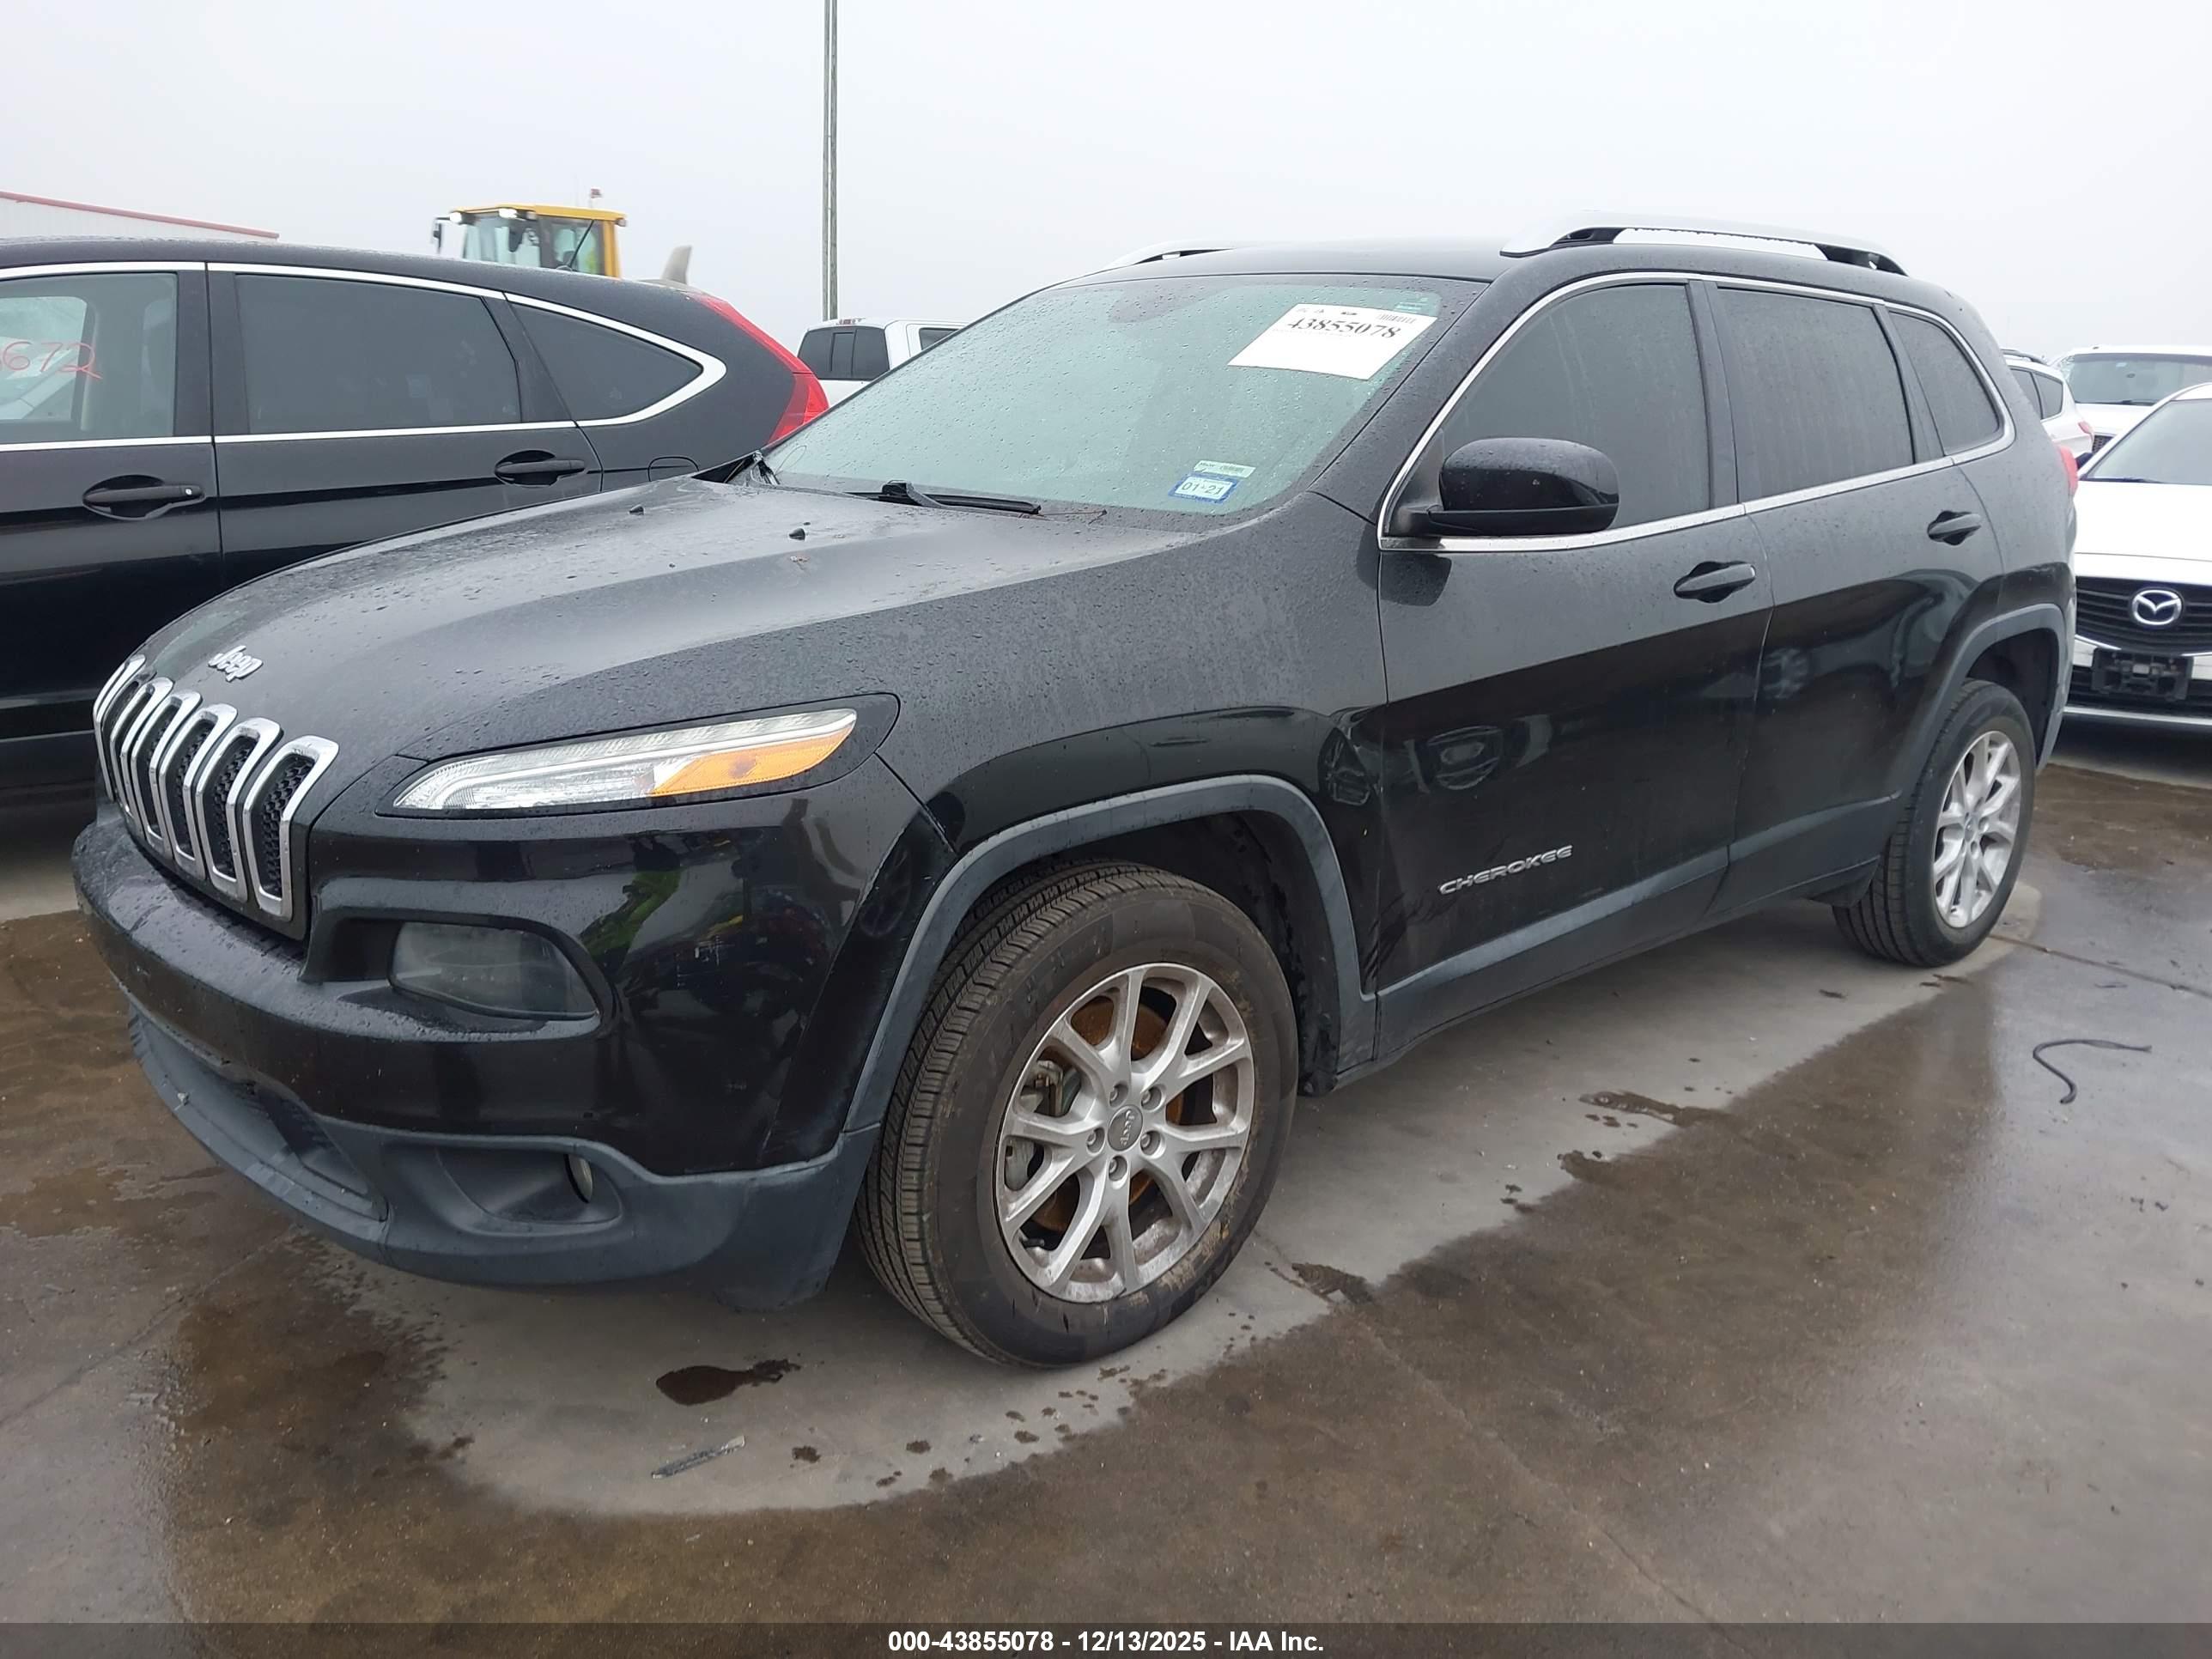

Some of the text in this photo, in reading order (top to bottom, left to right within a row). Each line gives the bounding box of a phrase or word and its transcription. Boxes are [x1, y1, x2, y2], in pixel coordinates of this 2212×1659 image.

[1285, 317, 1401, 338] 43855078
[208, 645, 264, 683] Jeep
[1438, 844, 1573, 896] CHEROKEE
